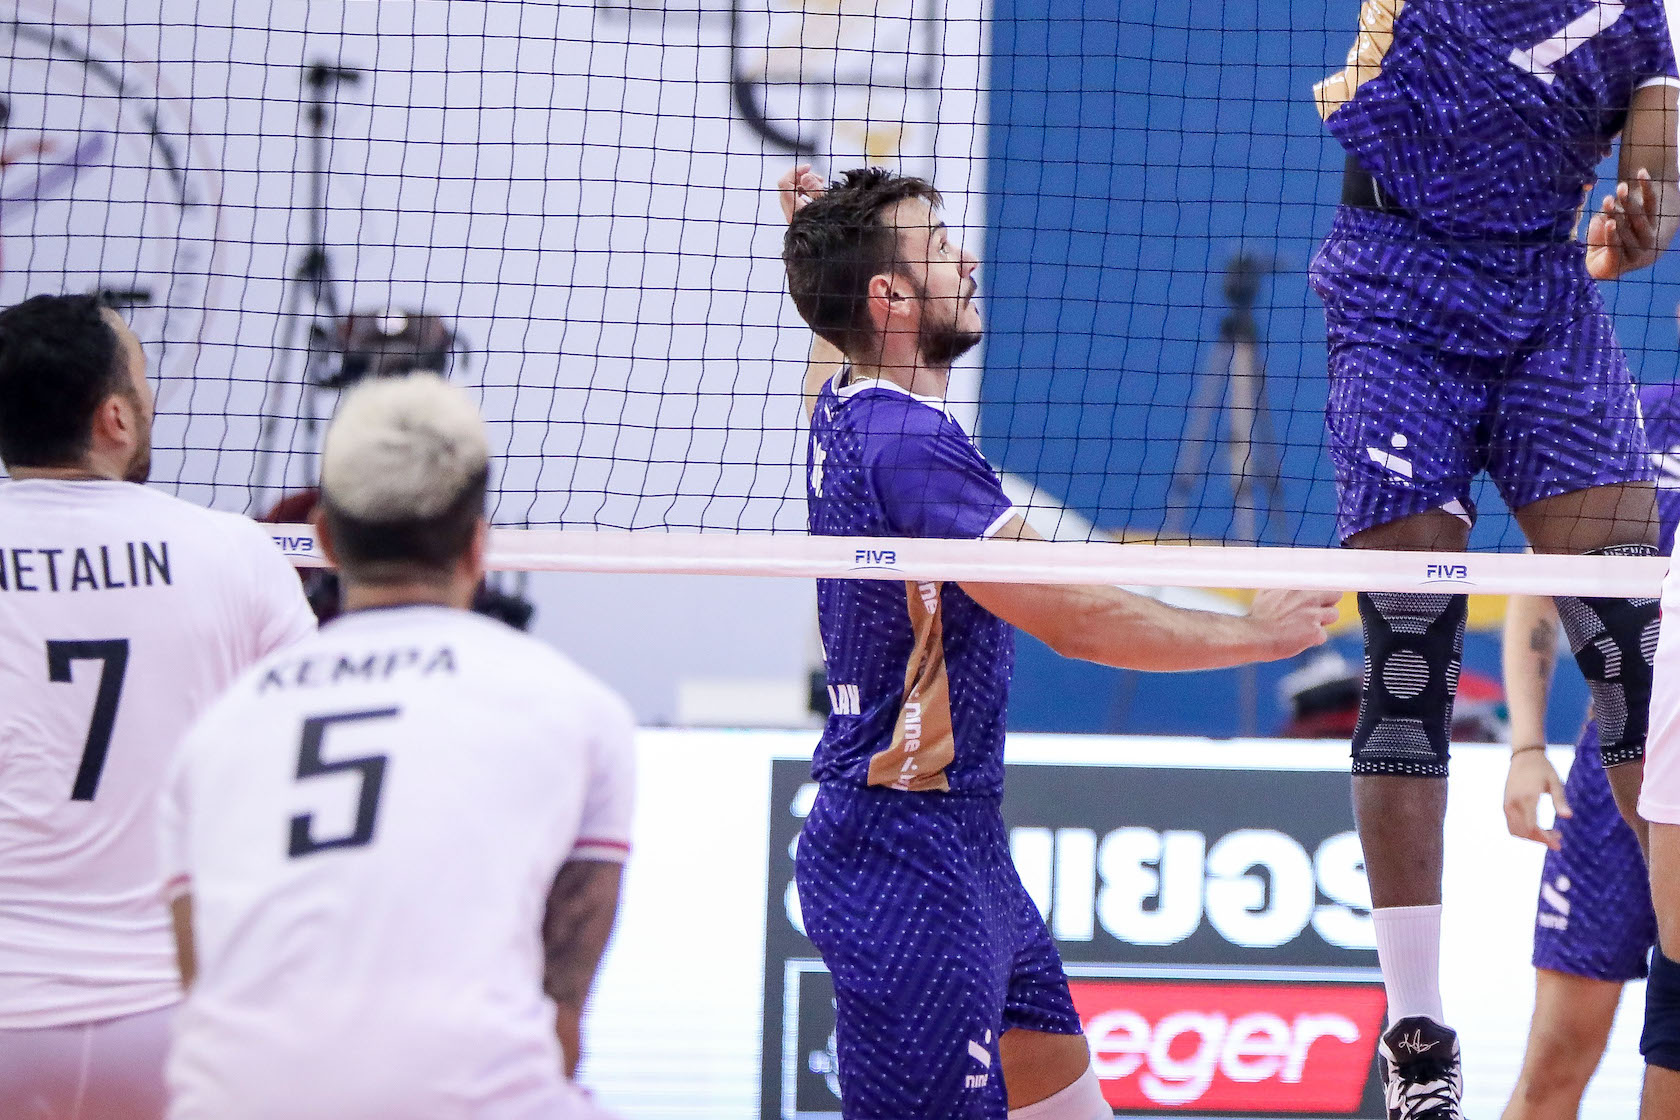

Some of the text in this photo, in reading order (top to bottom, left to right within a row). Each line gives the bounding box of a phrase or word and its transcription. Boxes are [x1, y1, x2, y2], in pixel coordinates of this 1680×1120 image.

[855, 549, 896, 565] FIVB
[1427, 564, 1468, 579] FIVB
[46, 638, 130, 802] 7
[287, 705, 402, 860] 5
[1088, 1008, 1362, 1106] eger
